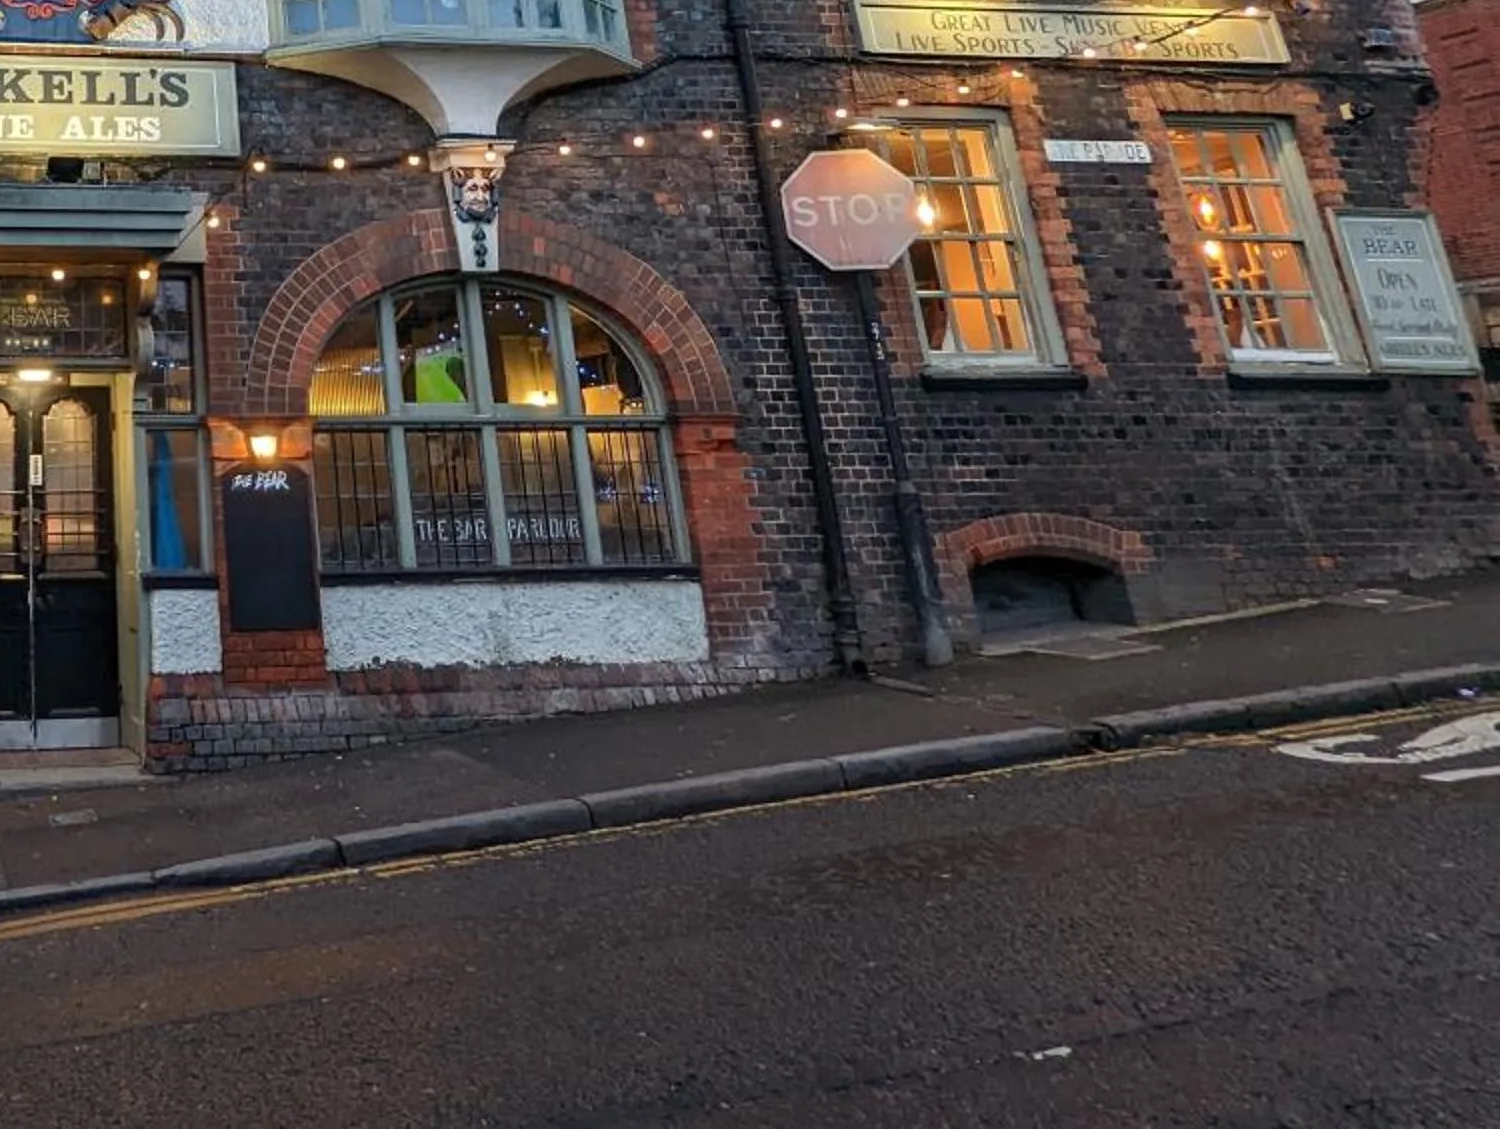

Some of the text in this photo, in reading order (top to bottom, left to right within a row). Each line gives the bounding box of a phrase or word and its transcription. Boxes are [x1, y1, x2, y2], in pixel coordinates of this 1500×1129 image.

[931, 10, 1208, 39] GREAT LIVE MUSIC VEN
[895, 31, 945, 52] LIVE
[952, 33, 1035, 55] SPORTS
[1160, 41, 1241, 60] SPORTS
[60, 115, 162, 143] ALES
[791, 192, 908, 228] STOP
[1363, 238, 1419, 255] BEAR
[416, 520, 449, 541] THE
[454, 519, 487, 541] BAR
